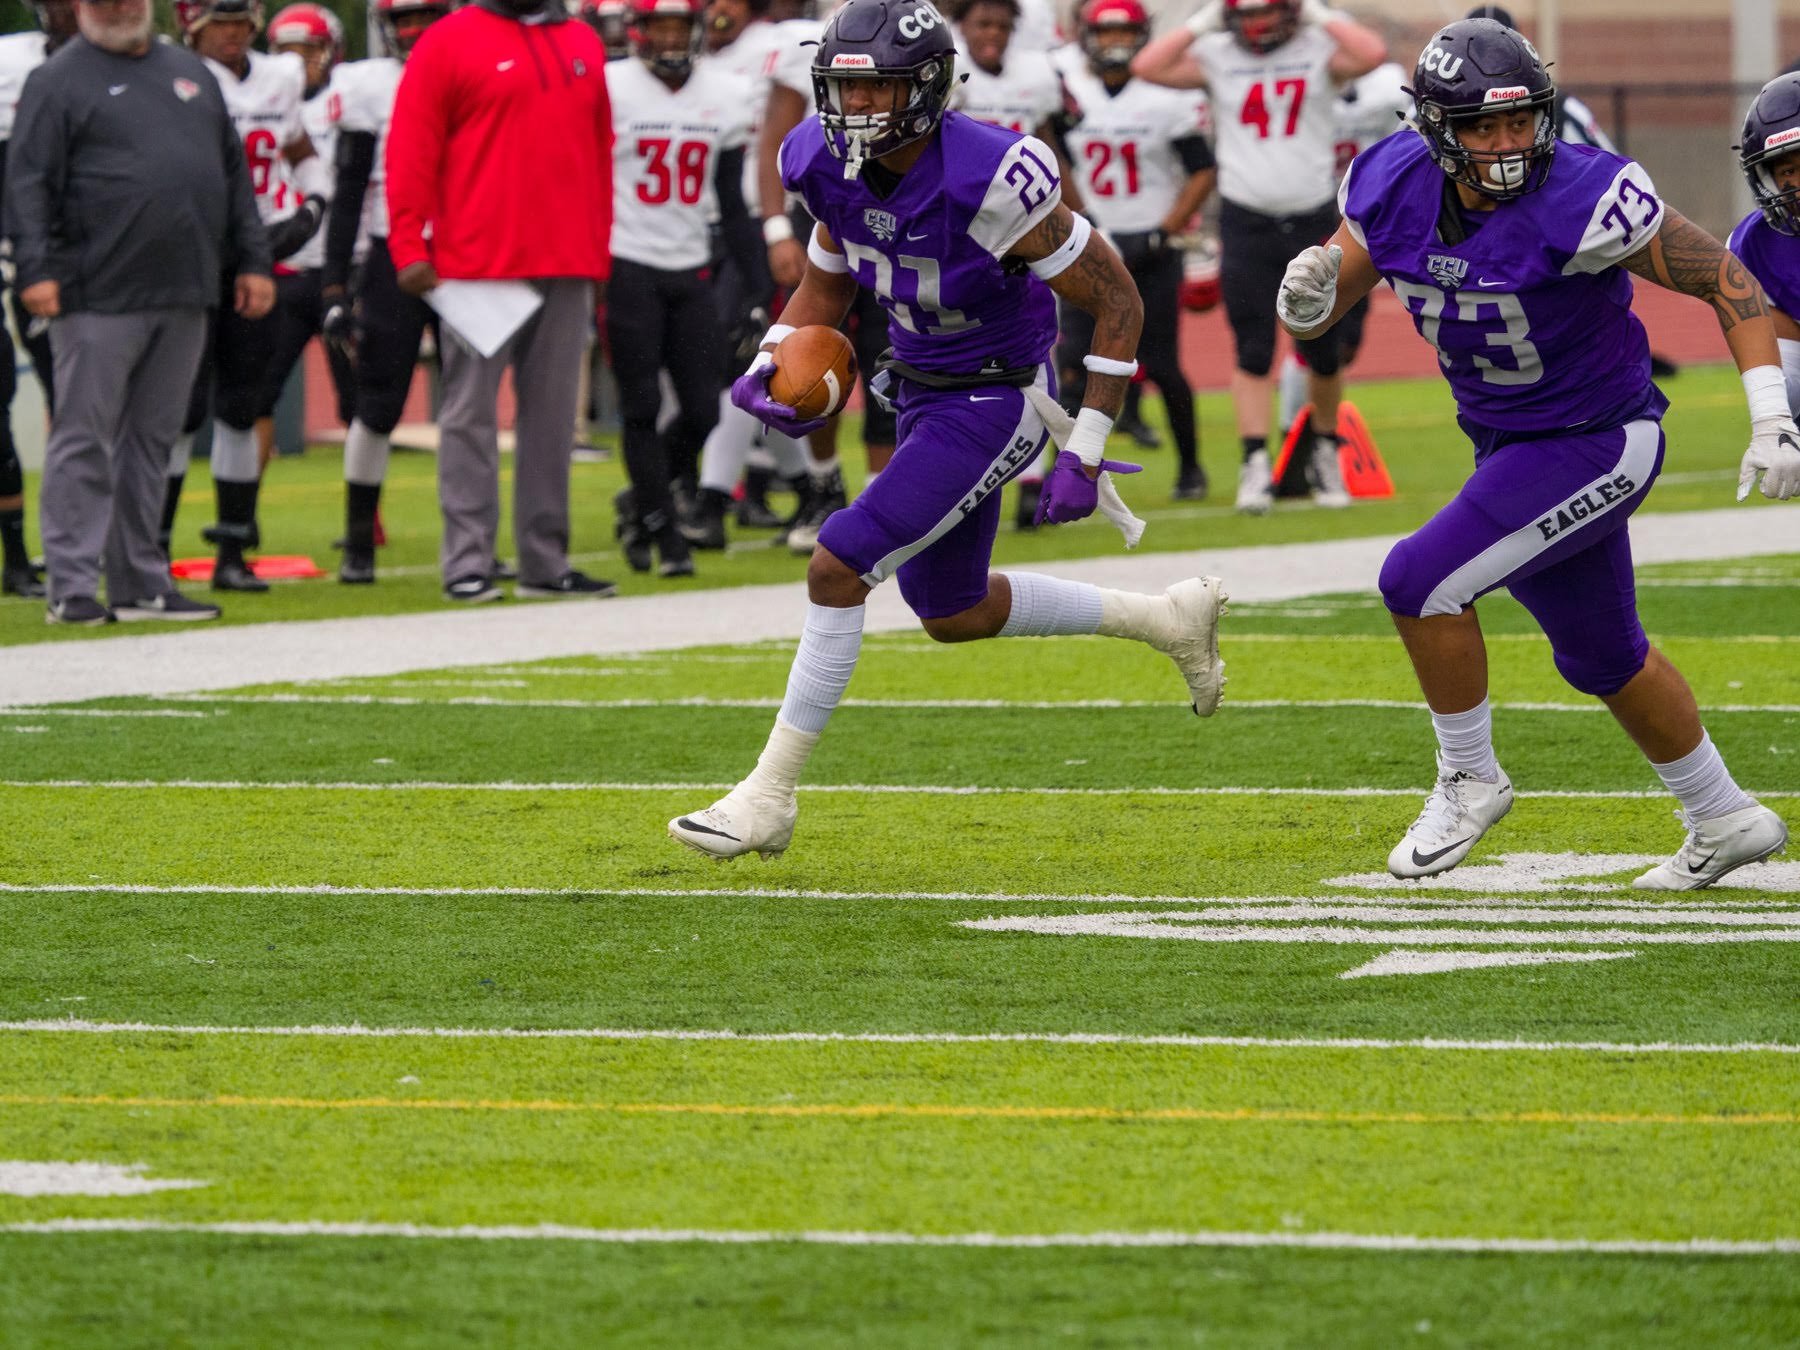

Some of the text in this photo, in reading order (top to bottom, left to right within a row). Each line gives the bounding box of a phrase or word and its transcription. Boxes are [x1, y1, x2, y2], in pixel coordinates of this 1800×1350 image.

[898, 2, 943, 39] CCU
[835, 57, 869, 65] Riddell
[1418, 41, 1464, 79] CCU
[1240, 78, 1306, 139] 47
[1491, 89, 1526, 99] Riddell
[636, 138, 709, 205] 38
[1005, 146, 1061, 216] 21
[1084, 141, 1141, 197] 21
[1600, 178, 1660, 247] 73
[841, 237, 983, 336] 21
[1427, 254, 1470, 279] CCU
[1392, 276, 1544, 386] 73
[958, 435, 1034, 516] EAGLES
[1536, 474, 1636, 541] EAGLES
